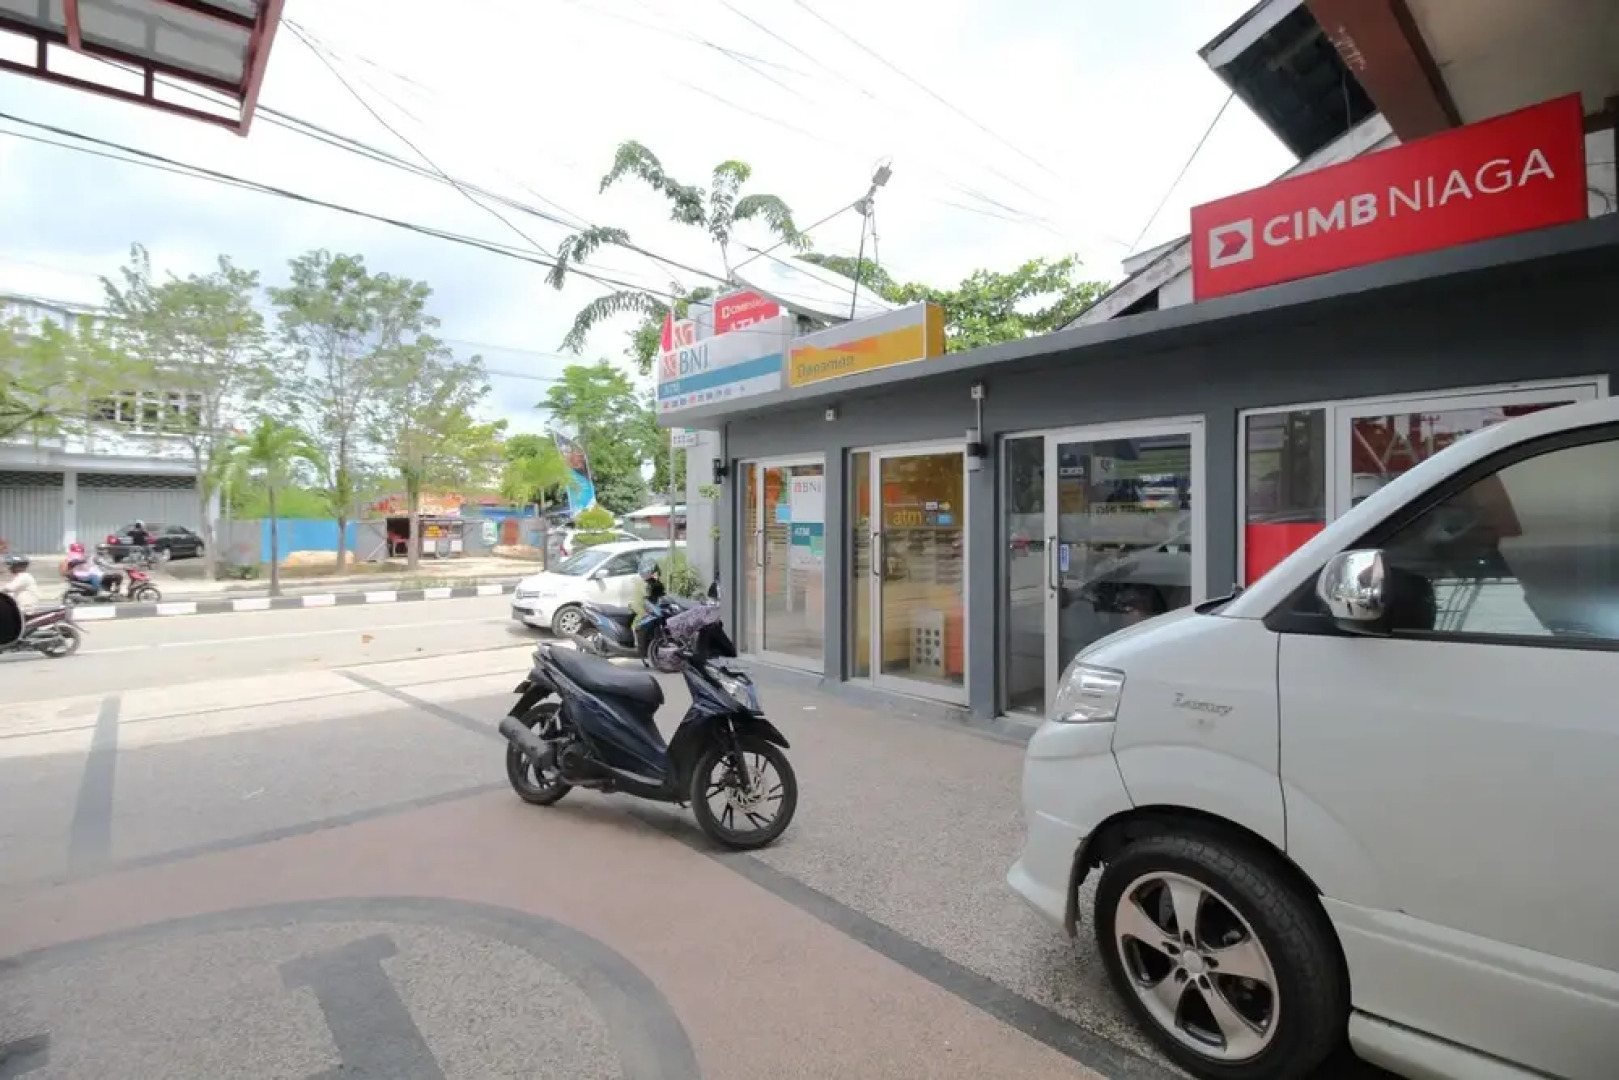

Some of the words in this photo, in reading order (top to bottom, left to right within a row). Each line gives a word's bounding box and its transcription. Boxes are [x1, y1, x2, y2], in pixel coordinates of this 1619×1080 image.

[1263, 193, 1378, 247] CIMB
[1389, 148, 1554, 217] NIAGA
[680, 343, 708, 374] BNI
[802, 480, 821, 493] BNI
[893, 509, 922, 525] atm
